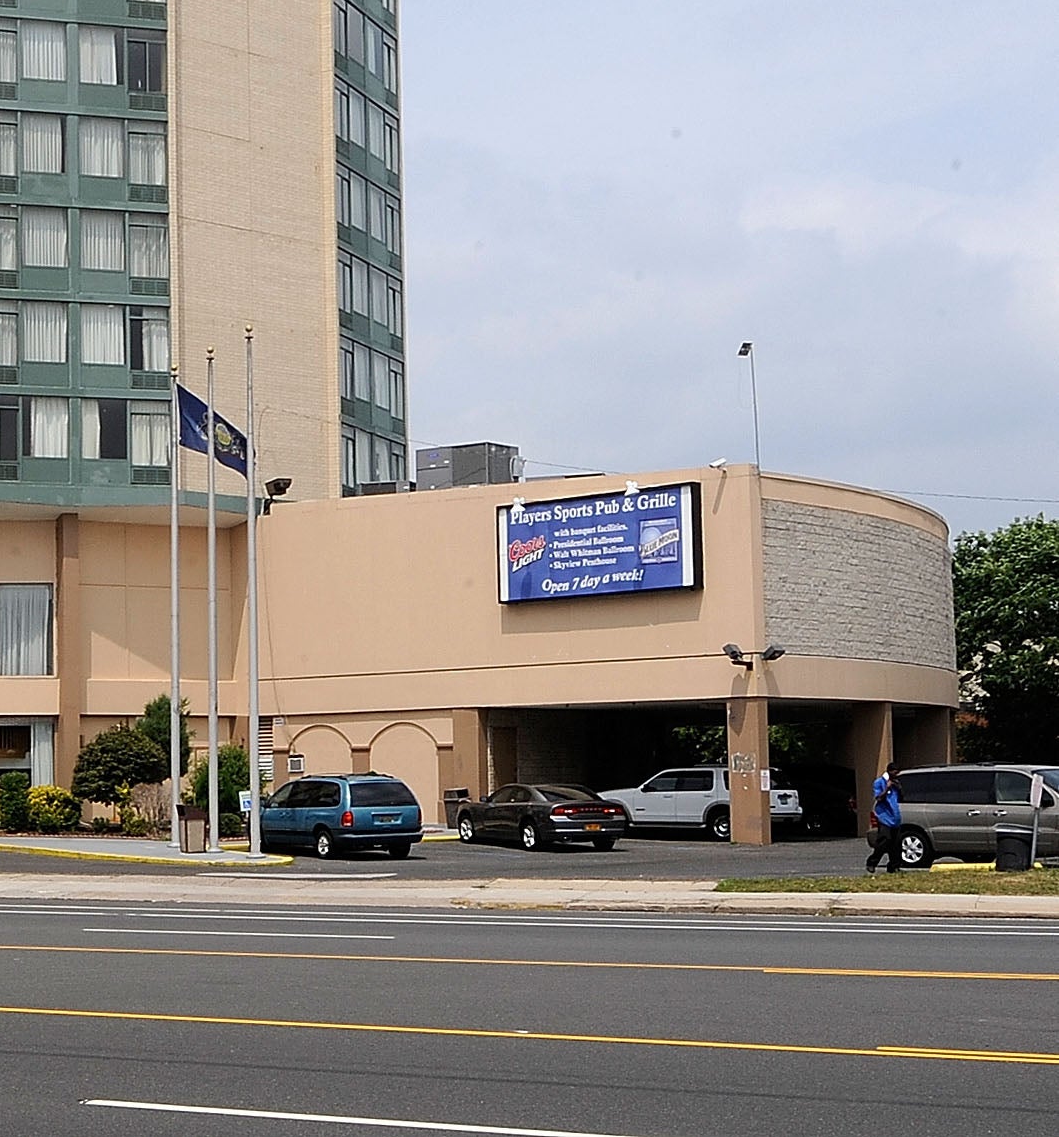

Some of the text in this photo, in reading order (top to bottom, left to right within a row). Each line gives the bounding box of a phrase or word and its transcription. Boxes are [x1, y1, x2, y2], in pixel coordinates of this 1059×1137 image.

[510, 493, 676, 526] Players Sports Pub & Grille
[553, 528, 570, 537] with
[509, 534, 546, 561] Coors
[512, 548, 544, 572] LIGHT
[553, 560, 581, 570] Skyview
[542, 569, 644, 594] Open 7 day a week!
